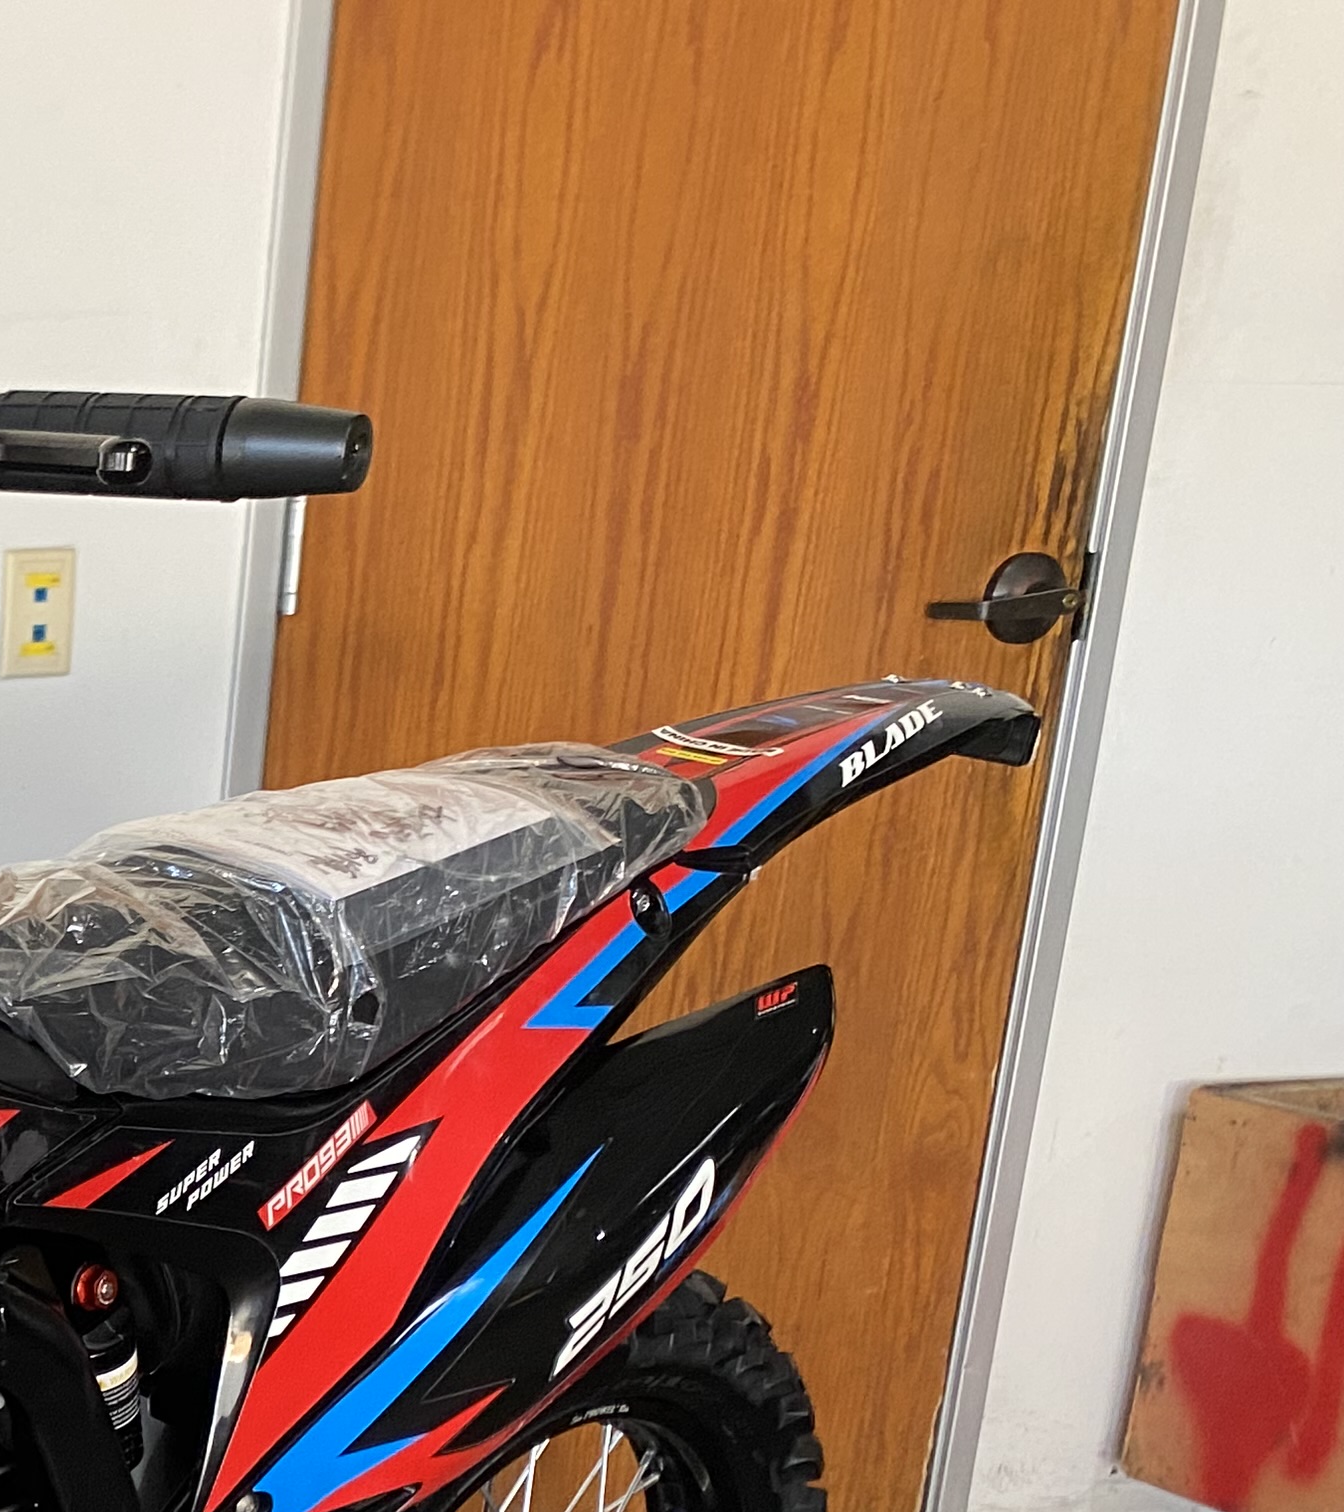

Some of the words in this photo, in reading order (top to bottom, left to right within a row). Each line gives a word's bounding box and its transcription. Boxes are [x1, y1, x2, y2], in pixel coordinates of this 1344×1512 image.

[838, 699, 944, 788] BLADE
[155, 1148, 222, 1216] SUPER
[186, 1140, 255, 1212] POWER
[550, 1158, 716, 1379] 250
